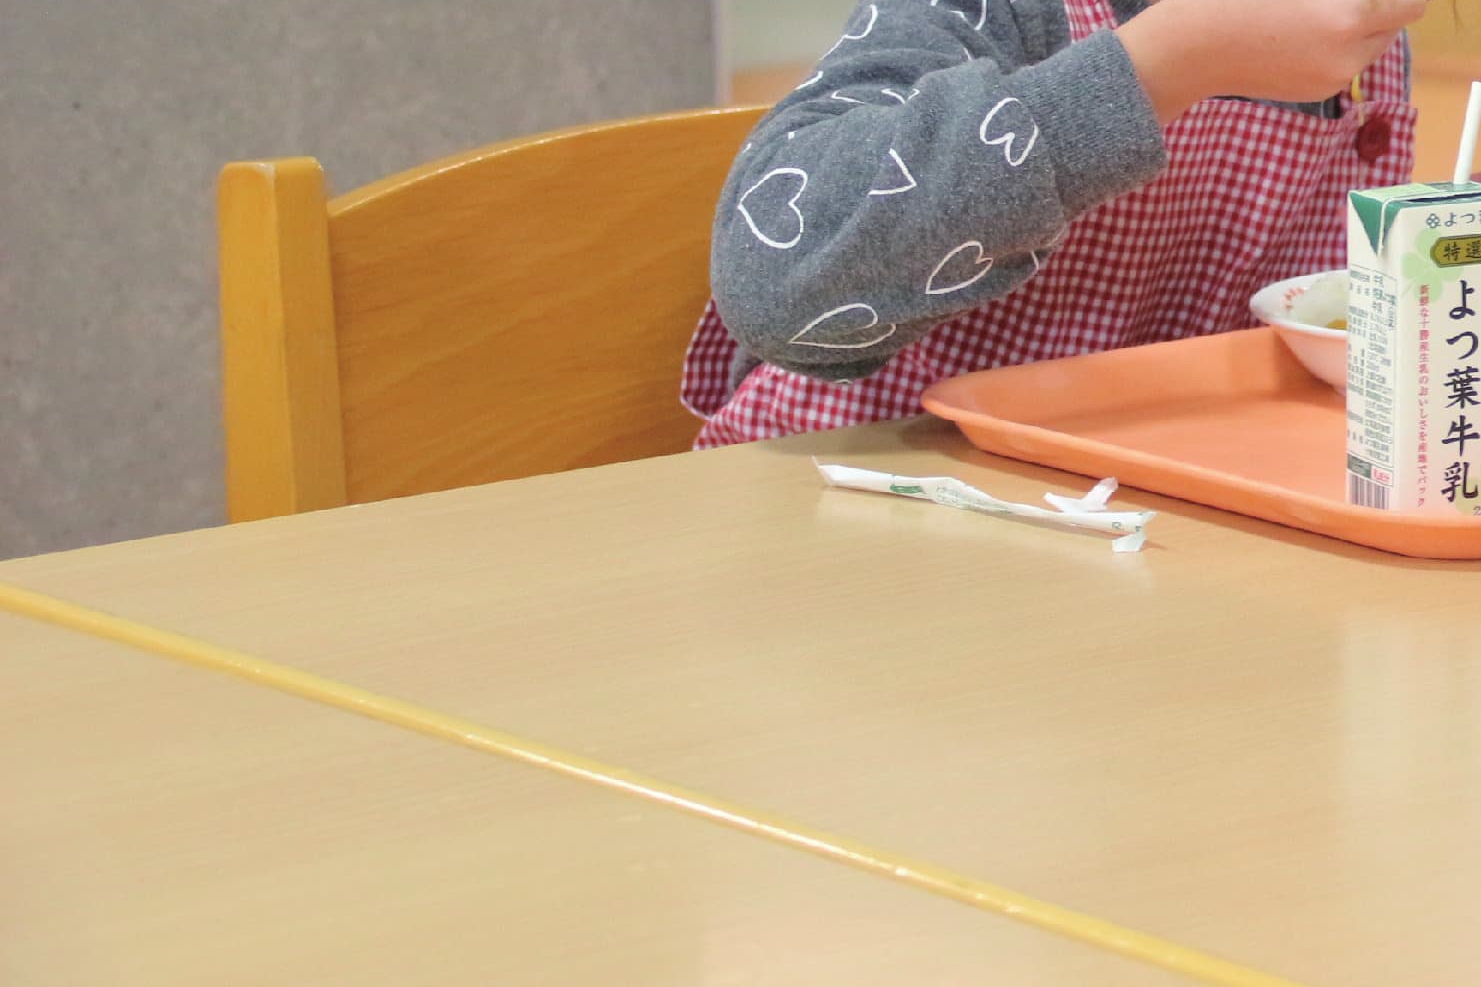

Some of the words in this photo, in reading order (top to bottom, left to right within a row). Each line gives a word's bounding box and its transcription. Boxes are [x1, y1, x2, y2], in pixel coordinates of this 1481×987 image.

[1443, 240, 1481, 261] 特選
[1440, 280, 1481, 502] よつ葉牛乳
